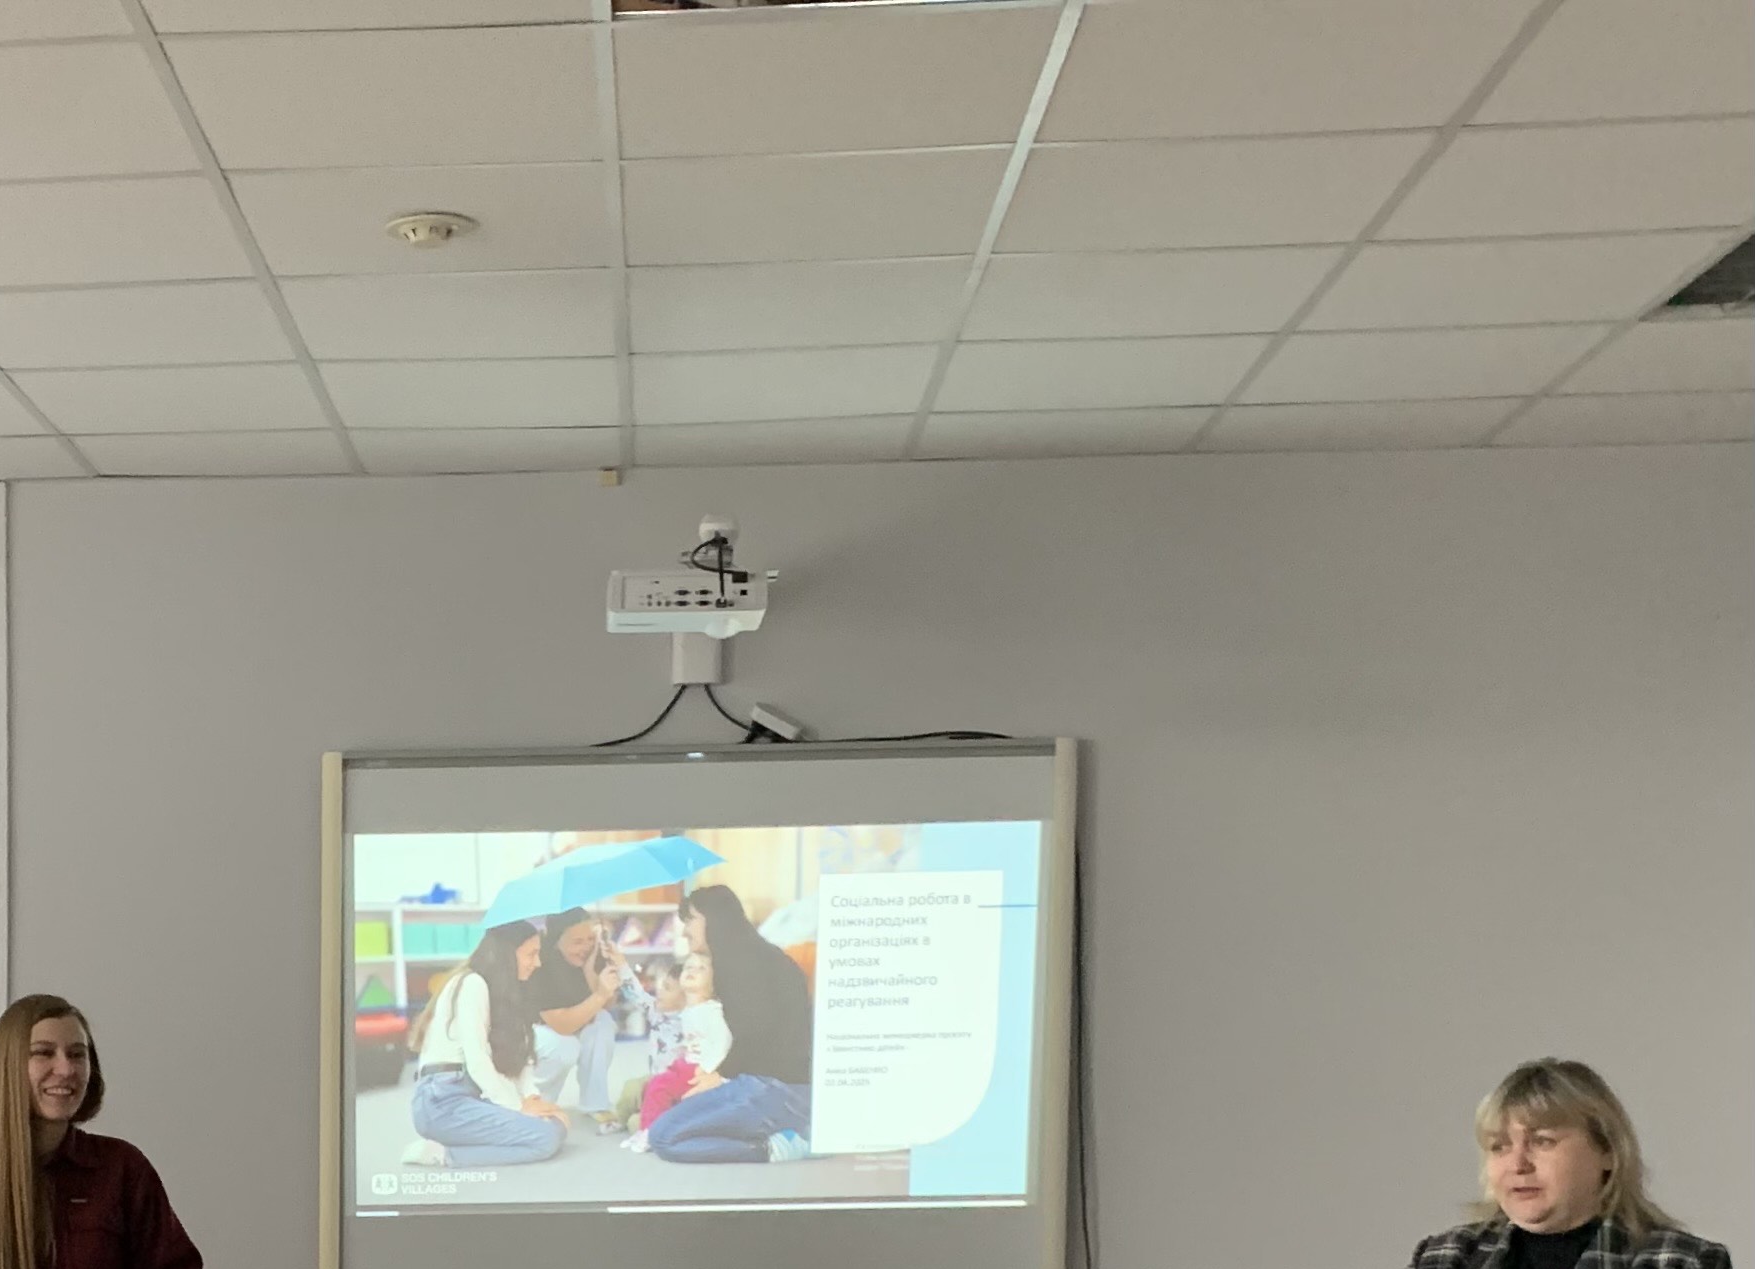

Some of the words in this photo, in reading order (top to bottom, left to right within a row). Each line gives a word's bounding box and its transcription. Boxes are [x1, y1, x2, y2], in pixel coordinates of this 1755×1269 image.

[908, 892, 960, 906] робота
[830, 916, 928, 928] міжнародних
[828, 957, 881, 970] умовах
[827, 974, 938, 988] надзвичайного
[827, 996, 910, 1010] реагування
[401, 1173, 425, 1183] SOS
[428, 1171, 497, 1183] CHILDREN'S
[401, 1183, 457, 1194] VILLAGES
